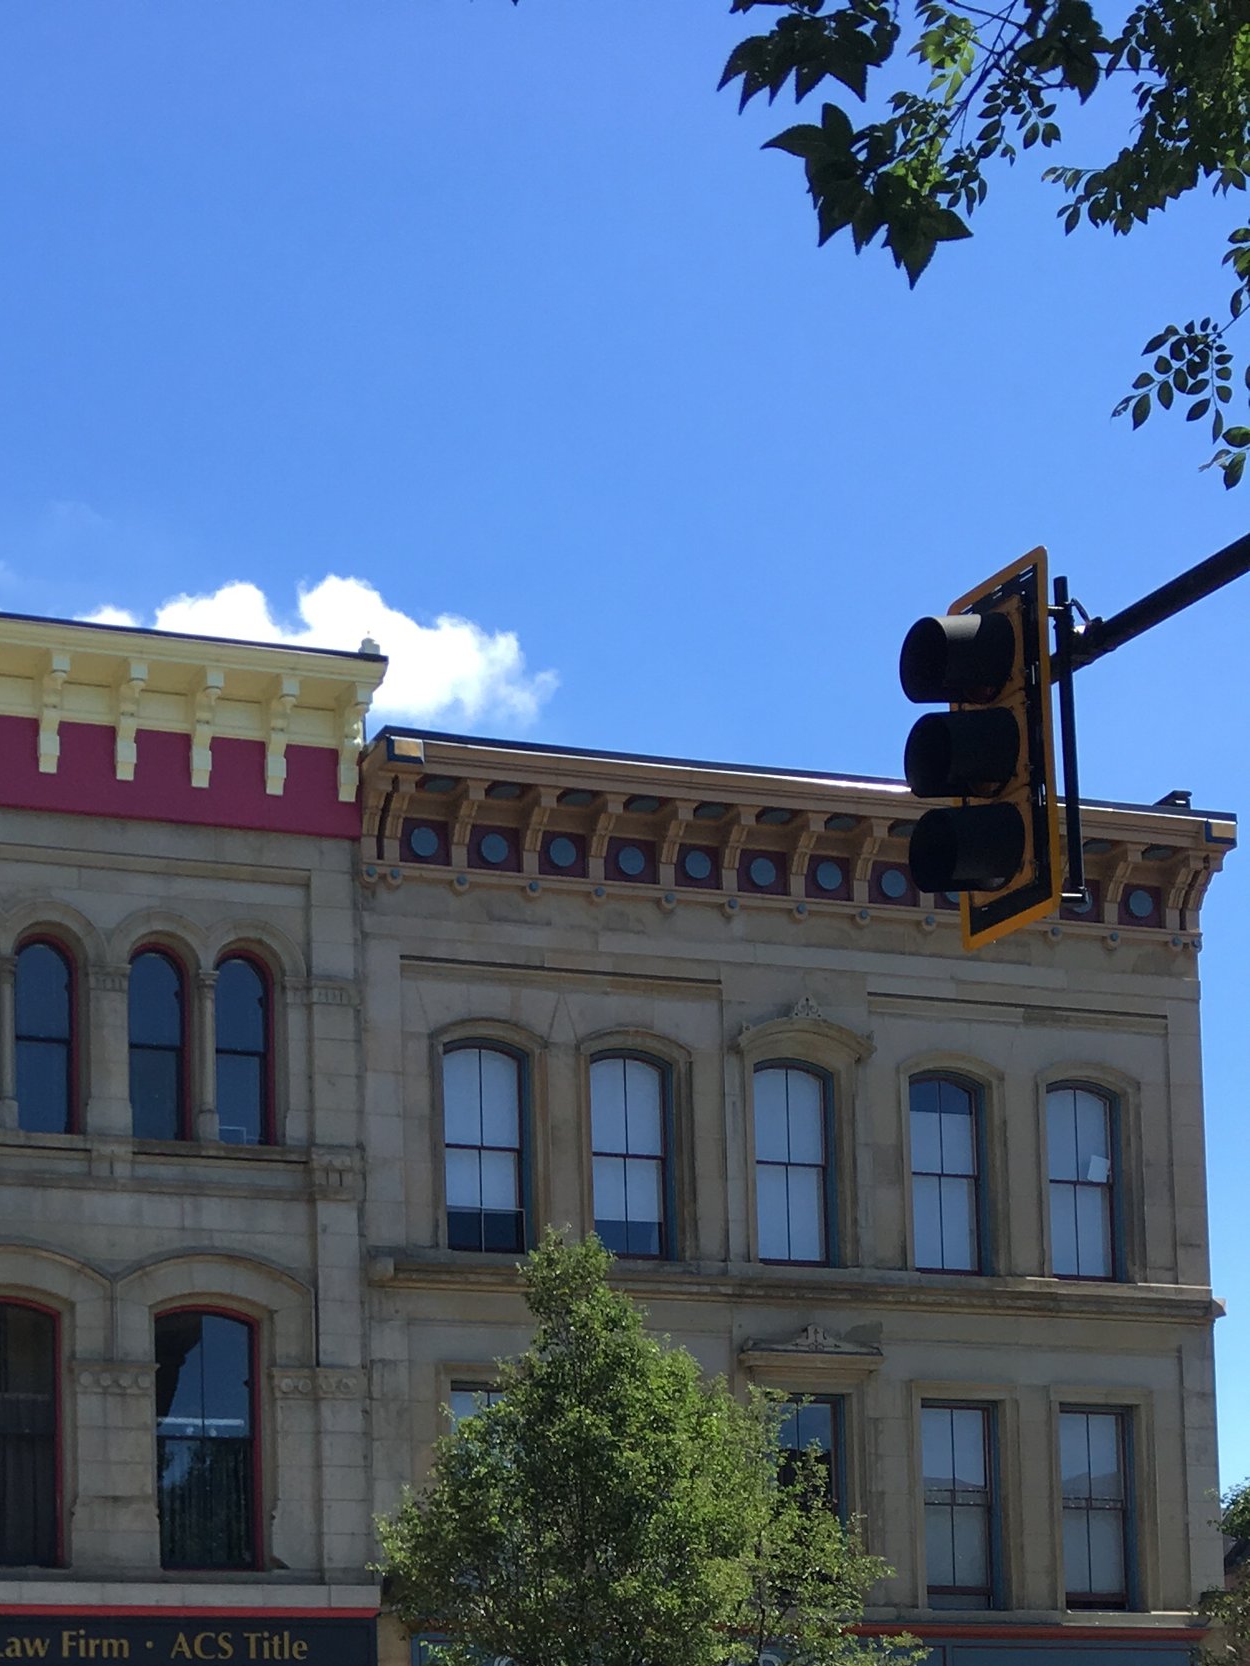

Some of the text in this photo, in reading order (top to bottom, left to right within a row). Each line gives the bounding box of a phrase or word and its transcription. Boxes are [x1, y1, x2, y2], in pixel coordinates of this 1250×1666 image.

[61, 1629, 130, 1659] Firm
[170, 1632, 234, 1660] ACS
[243, 1631, 309, 1660] Title
